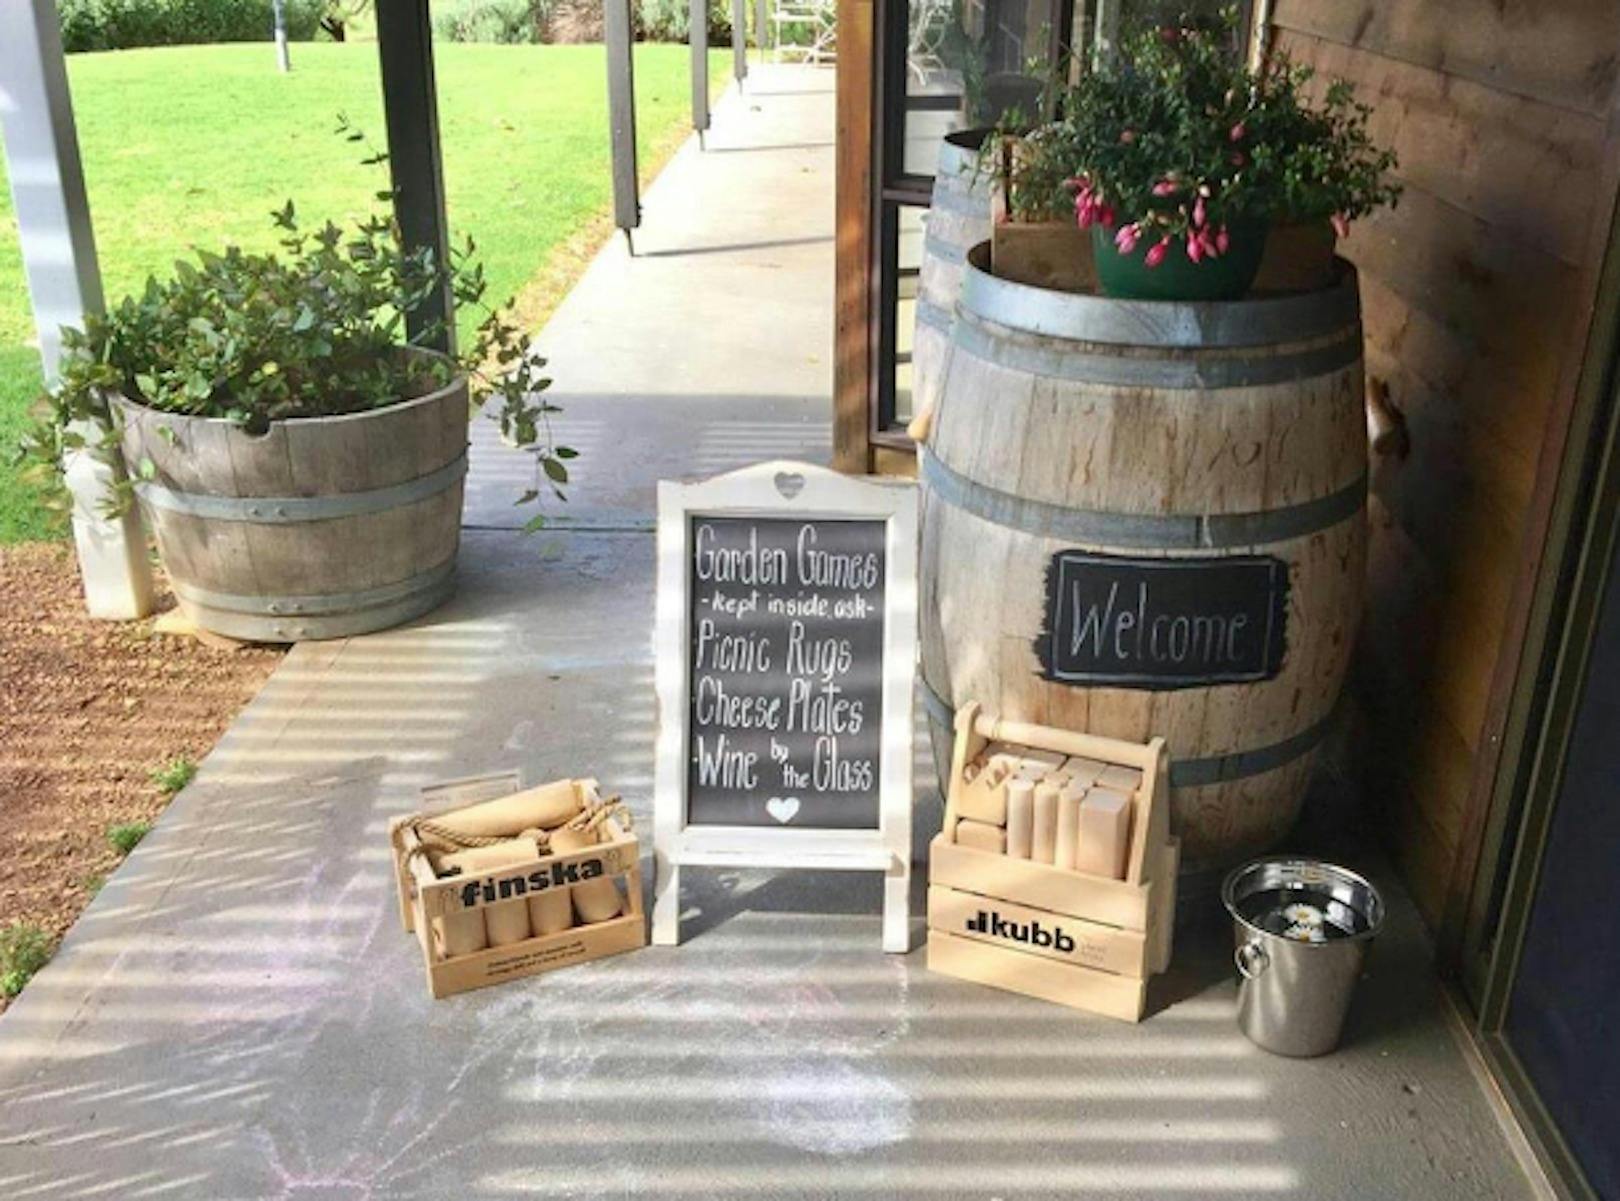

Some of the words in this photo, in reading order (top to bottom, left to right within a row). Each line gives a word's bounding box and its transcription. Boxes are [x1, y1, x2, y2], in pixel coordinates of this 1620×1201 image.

[695, 523, 788, 585] Garden
[797, 524, 879, 589] Games
[696, 618, 771, 673] Picnic
[786, 619, 853, 682] Rugs
[1070, 580, 1249, 664] Welcome
[697, 675, 782, 730] Cheese
[786, 677, 864, 735] Plates
[770, 736, 789, 764] by
[782, 764, 810, 789] the
[812, 735, 873, 792] Glass
[460, 857, 605, 907] finska
[991, 911, 1076, 954] kubb
